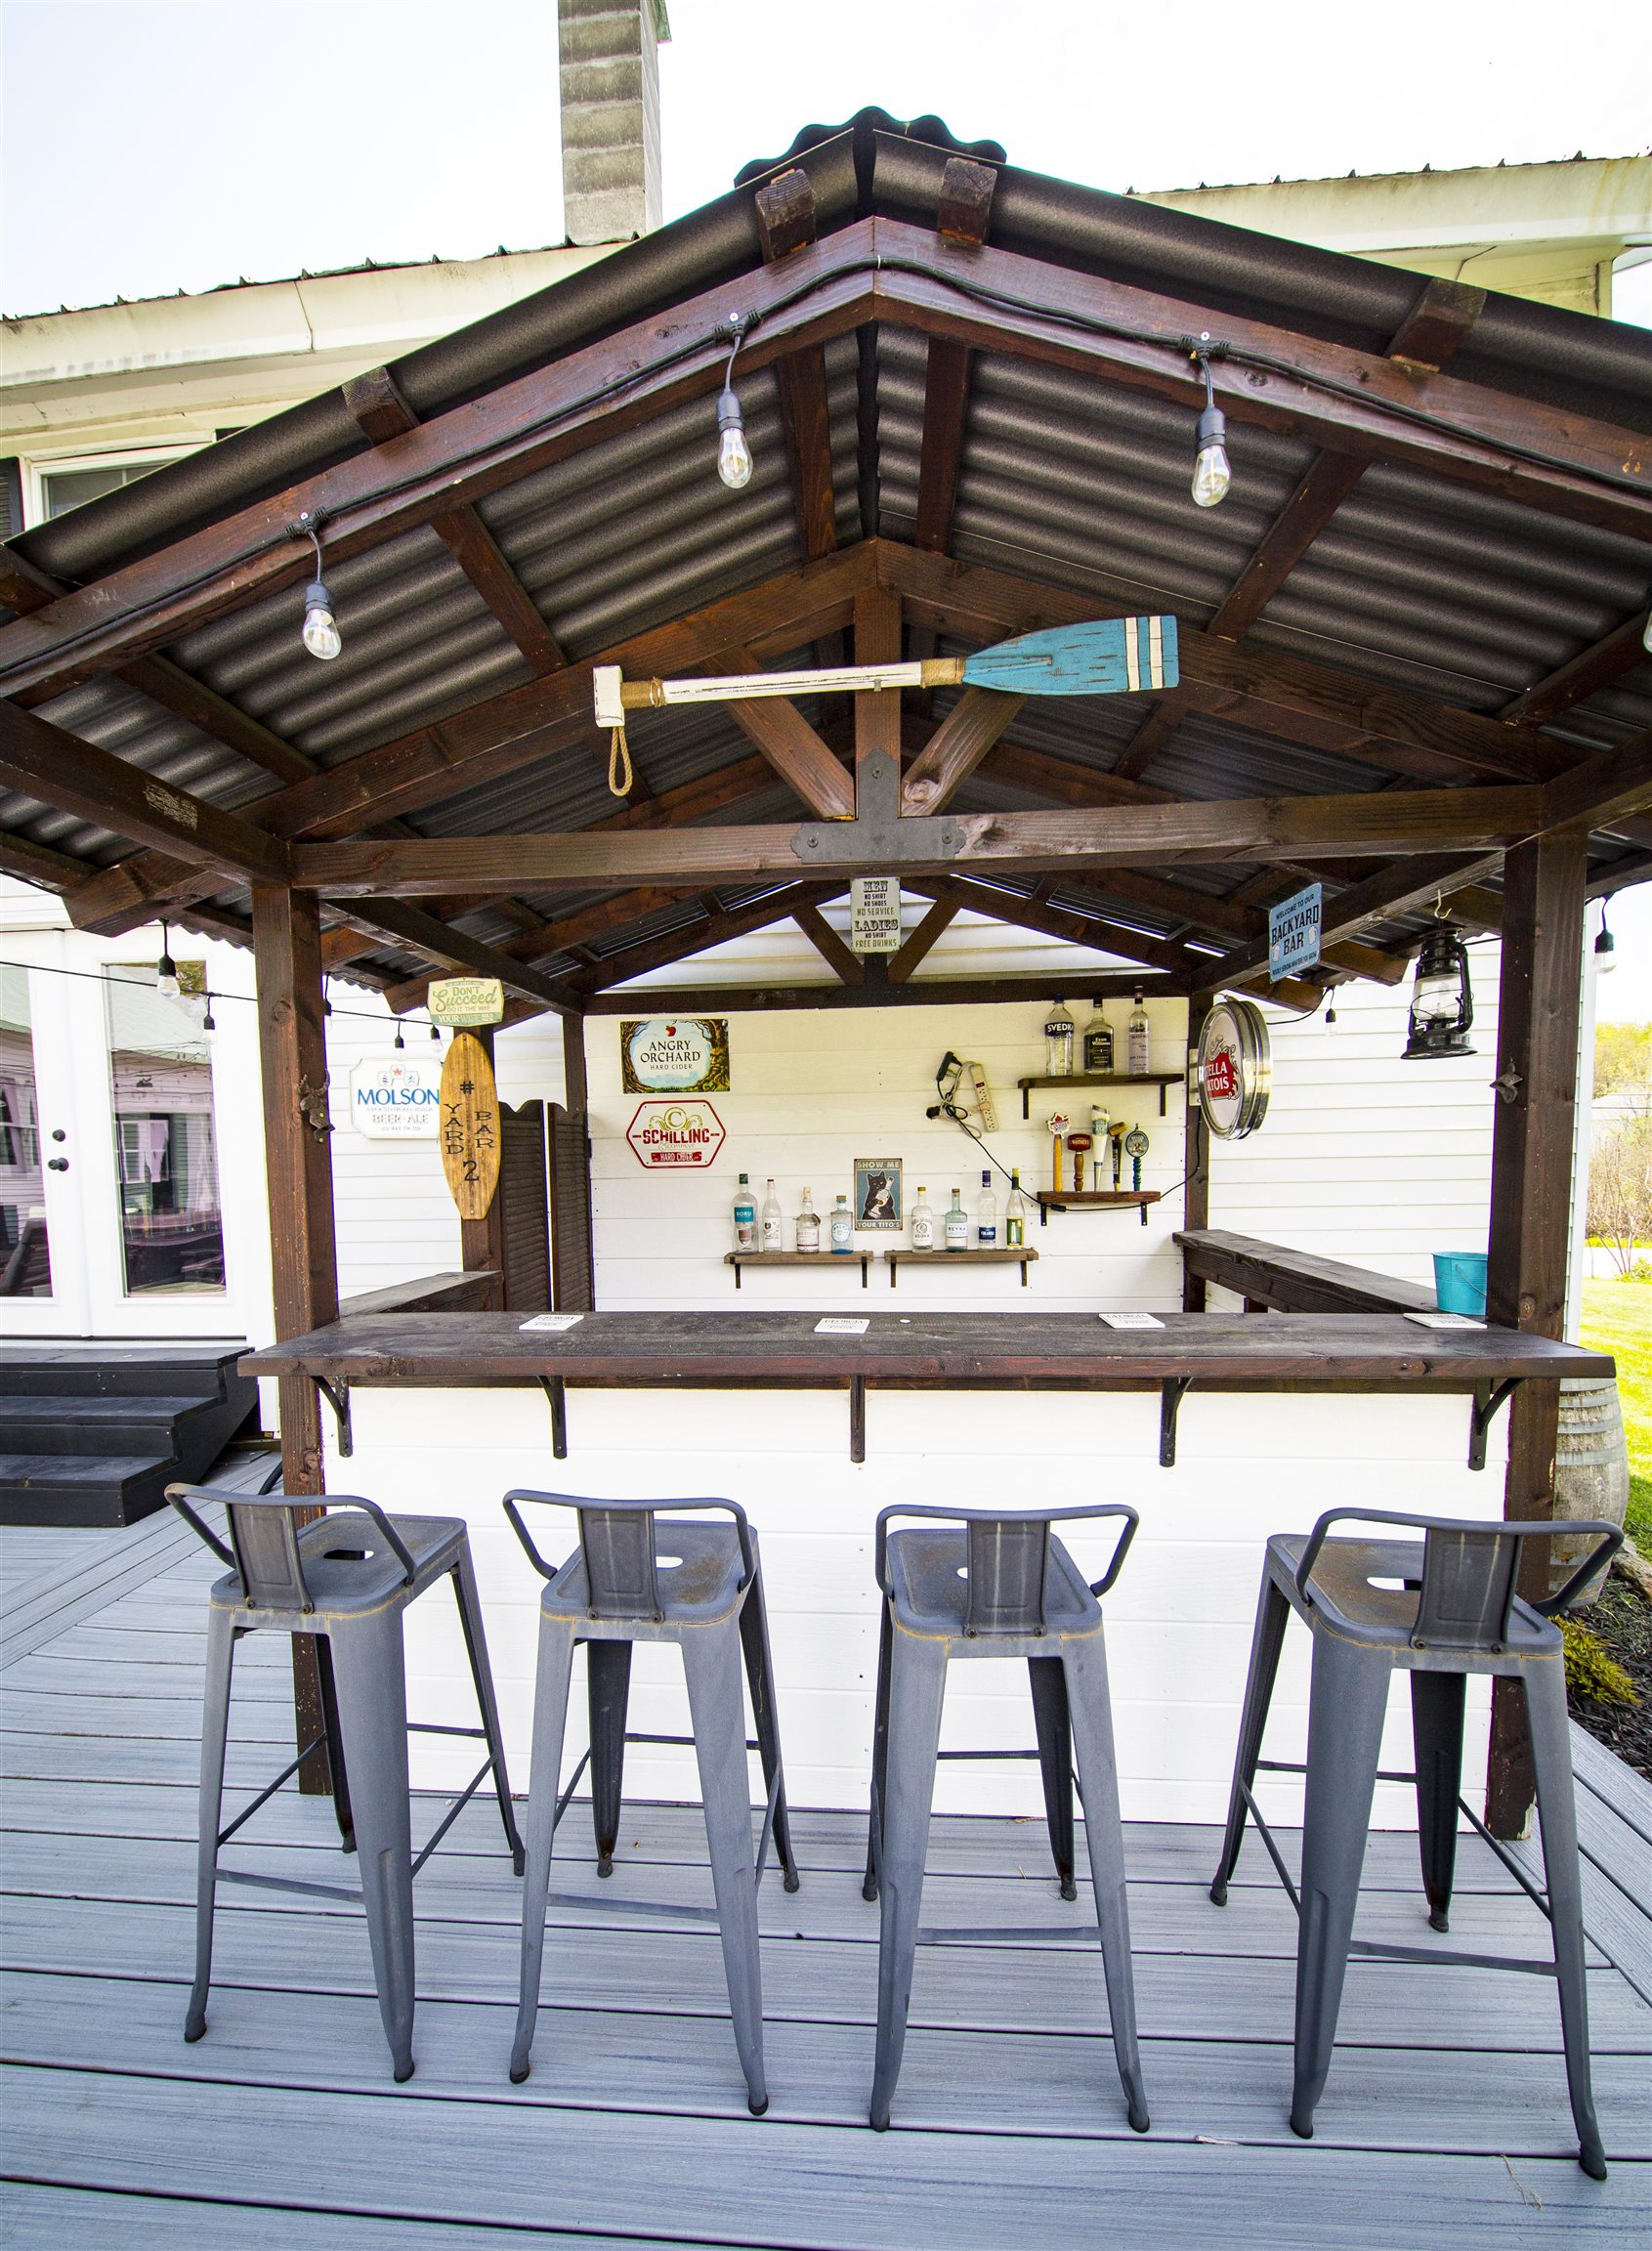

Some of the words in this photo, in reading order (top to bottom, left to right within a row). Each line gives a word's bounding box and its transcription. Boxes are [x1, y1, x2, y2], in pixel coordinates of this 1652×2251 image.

[864, 881, 888, 892] MEN
[857, 908, 867, 916] NO
[868, 907, 894, 916] SERVICE
[1276, 905, 1296, 919] WELCOME
[1297, 900, 1304, 909] TO
[1305, 894, 1314, 904] OUR
[854, 918, 899, 932] LADIES
[1271, 904, 1319, 948] BACKYARD
[855, 939, 871, 948] FREE
[872, 938, 897, 947] DRINKS
[1284, 931, 1304, 956] BAR
[433, 986, 497, 1012] Succeed
[452, 986, 481, 997] DON'T
[439, 1014, 461, 1023] YOUR
[649, 1041, 691, 1051] ANGRY
[640, 1051, 701, 1063] ORCHARD
[358, 1087, 440, 1105] MOLSON
[445, 1103, 465, 1155] YARD
[475, 1111, 495, 1149] BAR
[643, 1128, 710, 1144] SCHILLING
[659, 1153, 676, 1162] HARD
[676, 1153, 694, 1162] CIDER
[463, 1160, 479, 1182] 2
